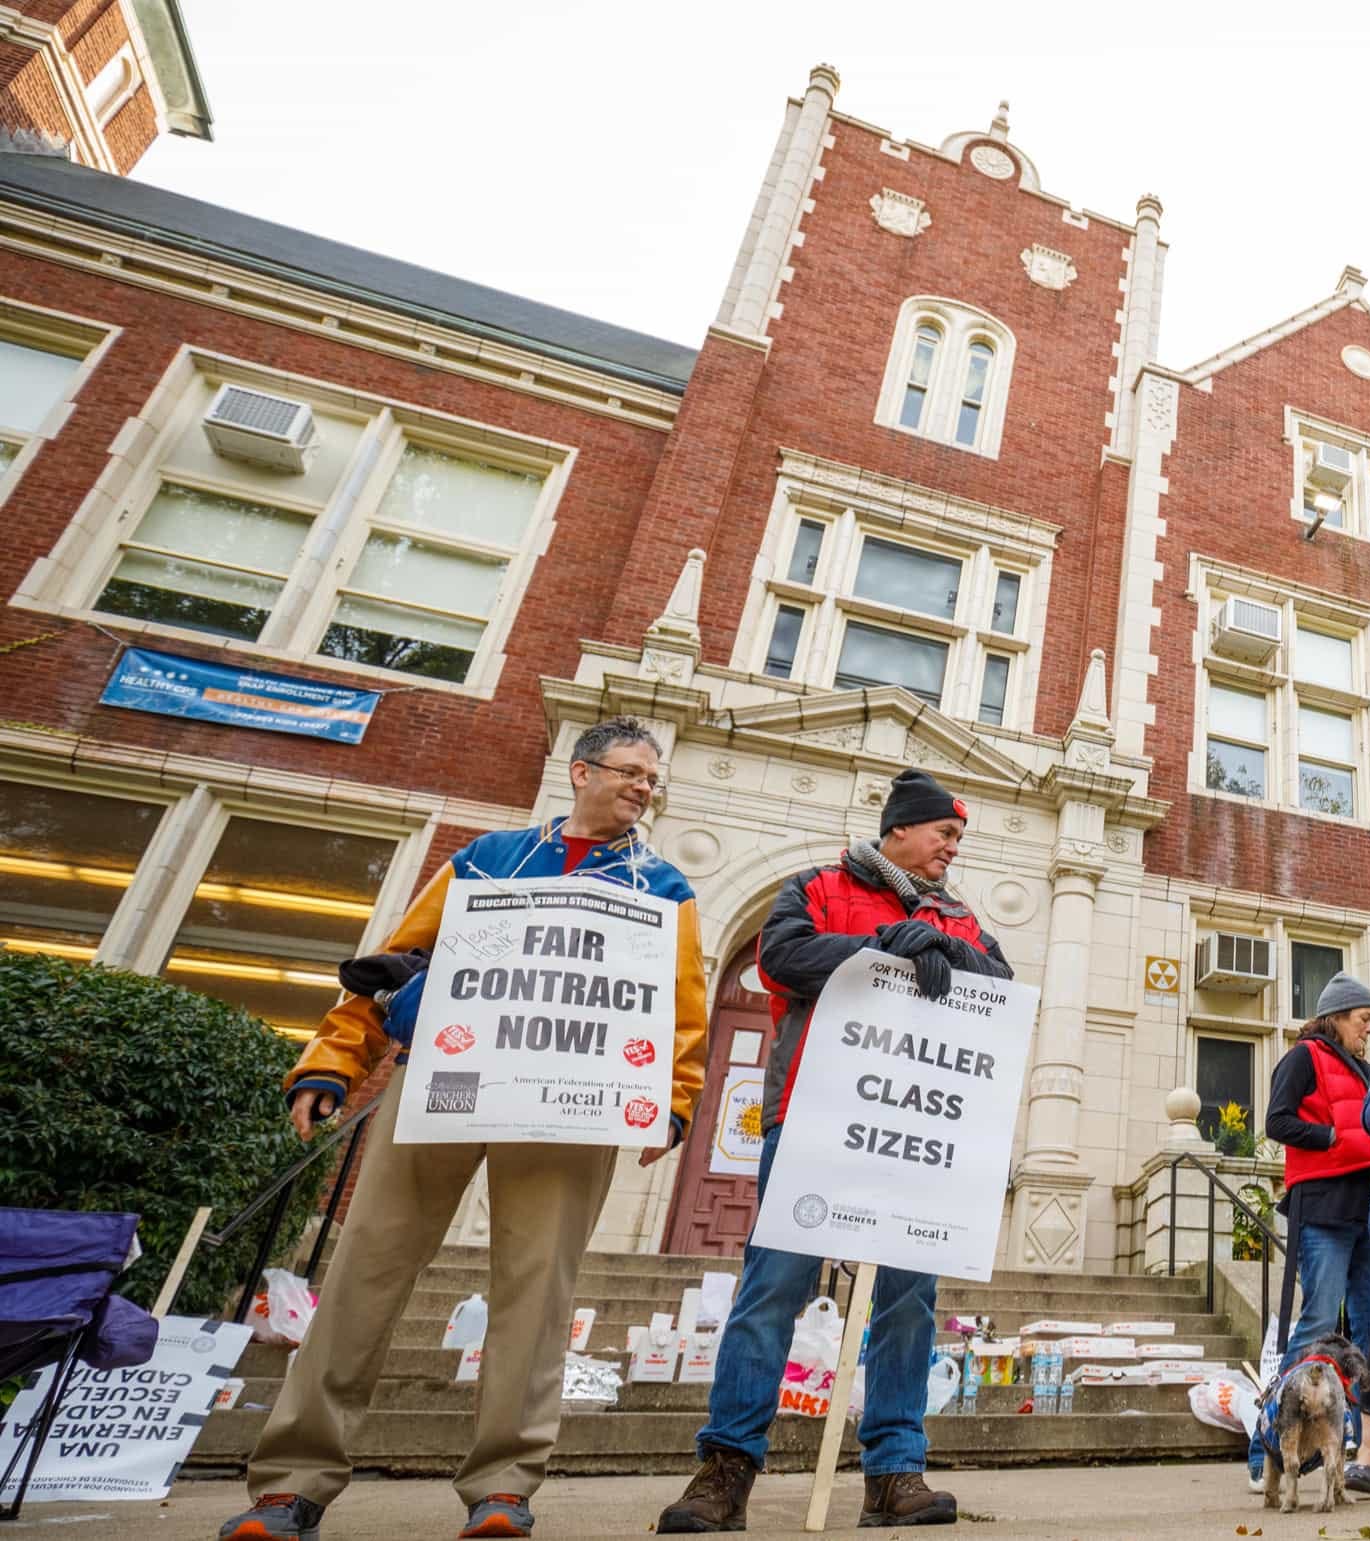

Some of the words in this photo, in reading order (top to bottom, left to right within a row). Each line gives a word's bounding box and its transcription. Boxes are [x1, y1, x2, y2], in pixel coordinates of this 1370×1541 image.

[534, 896, 568, 905] STAND
[568, 896, 608, 912] STRONG
[607, 903, 627, 916] AND
[627, 908, 659, 924] UNITED
[522, 925, 605, 962] FAIR
[869, 961, 891, 976] FOR
[892, 967, 917, 983] THE
[450, 967, 658, 1014] CONTRACT
[979, 991, 1007, 1006] OUR
[939, 995, 993, 1017] DESERVE
[495, 1015, 609, 1057] NOW!
[841, 1021, 995, 1080] SMALLER
[512, 1076, 555, 1085] American
[558, 1077, 604, 1089] Federation
[428, 1098, 475, 1111] UNION
[540, 1086, 604, 1107] Local
[613, 1090, 622, 1107] 1
[856, 1074, 964, 1121] CLASS
[560, 1108, 602, 1118] AFL-CIO
[843, 1123, 955, 1169] SIZES!
[831, 1212, 877, 1226] TEACHERS
[906, 1225, 940, 1241] Local
[941, 1231, 949, 1241] 1
[121, 1368, 193, 1386] CADA
[63, 1386, 182, 1404] ESCUELA
[54, 1404, 127, 1421] CADA
[133, 1406, 171, 1422] EN
[12, 1422, 185, 1441] ENFERMEA
[59, 1442, 121, 1458] UNA
[93, 1476, 150, 1486] ESTUDIANTES
